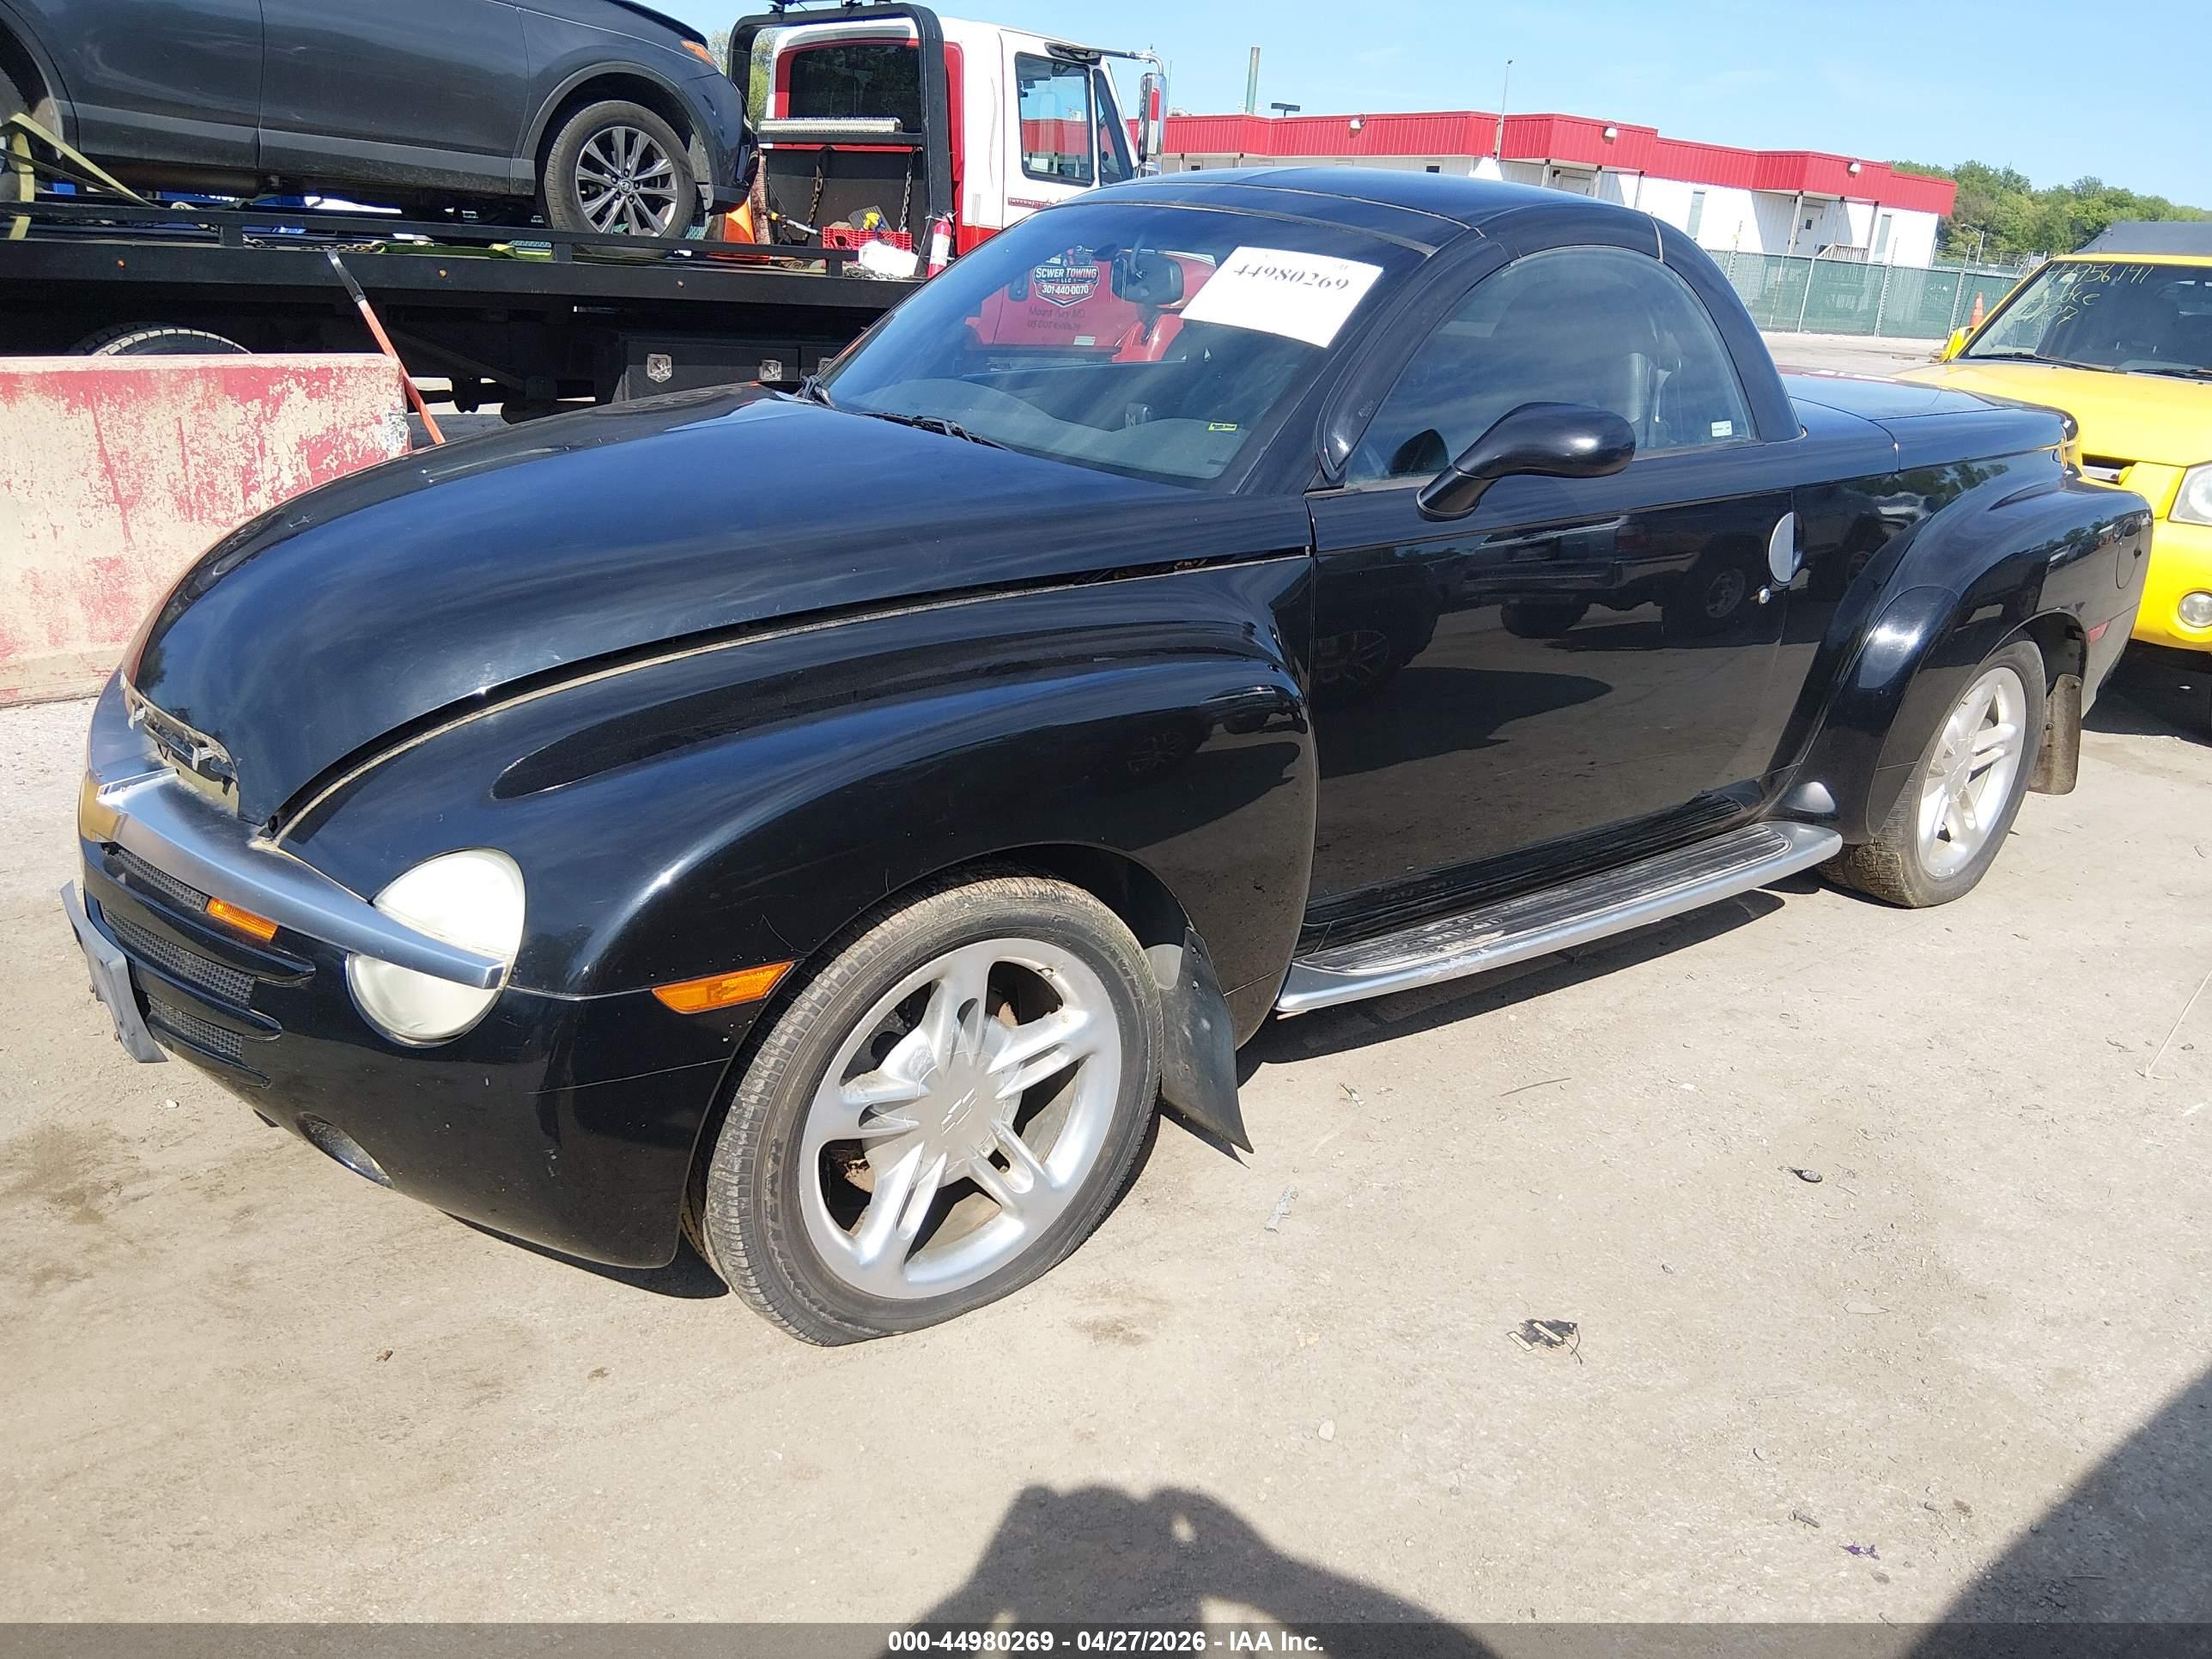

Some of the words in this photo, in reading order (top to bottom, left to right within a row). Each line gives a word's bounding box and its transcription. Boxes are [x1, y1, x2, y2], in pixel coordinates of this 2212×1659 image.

[1036, 267, 1065, 278] SCWER
[1066, 267, 1097, 278] TOWING
[1233, 264, 1350, 290] 44980269
[2045, 263, 2154, 284] 44956141
[1042, 284, 1089, 295] 301-440-0070
